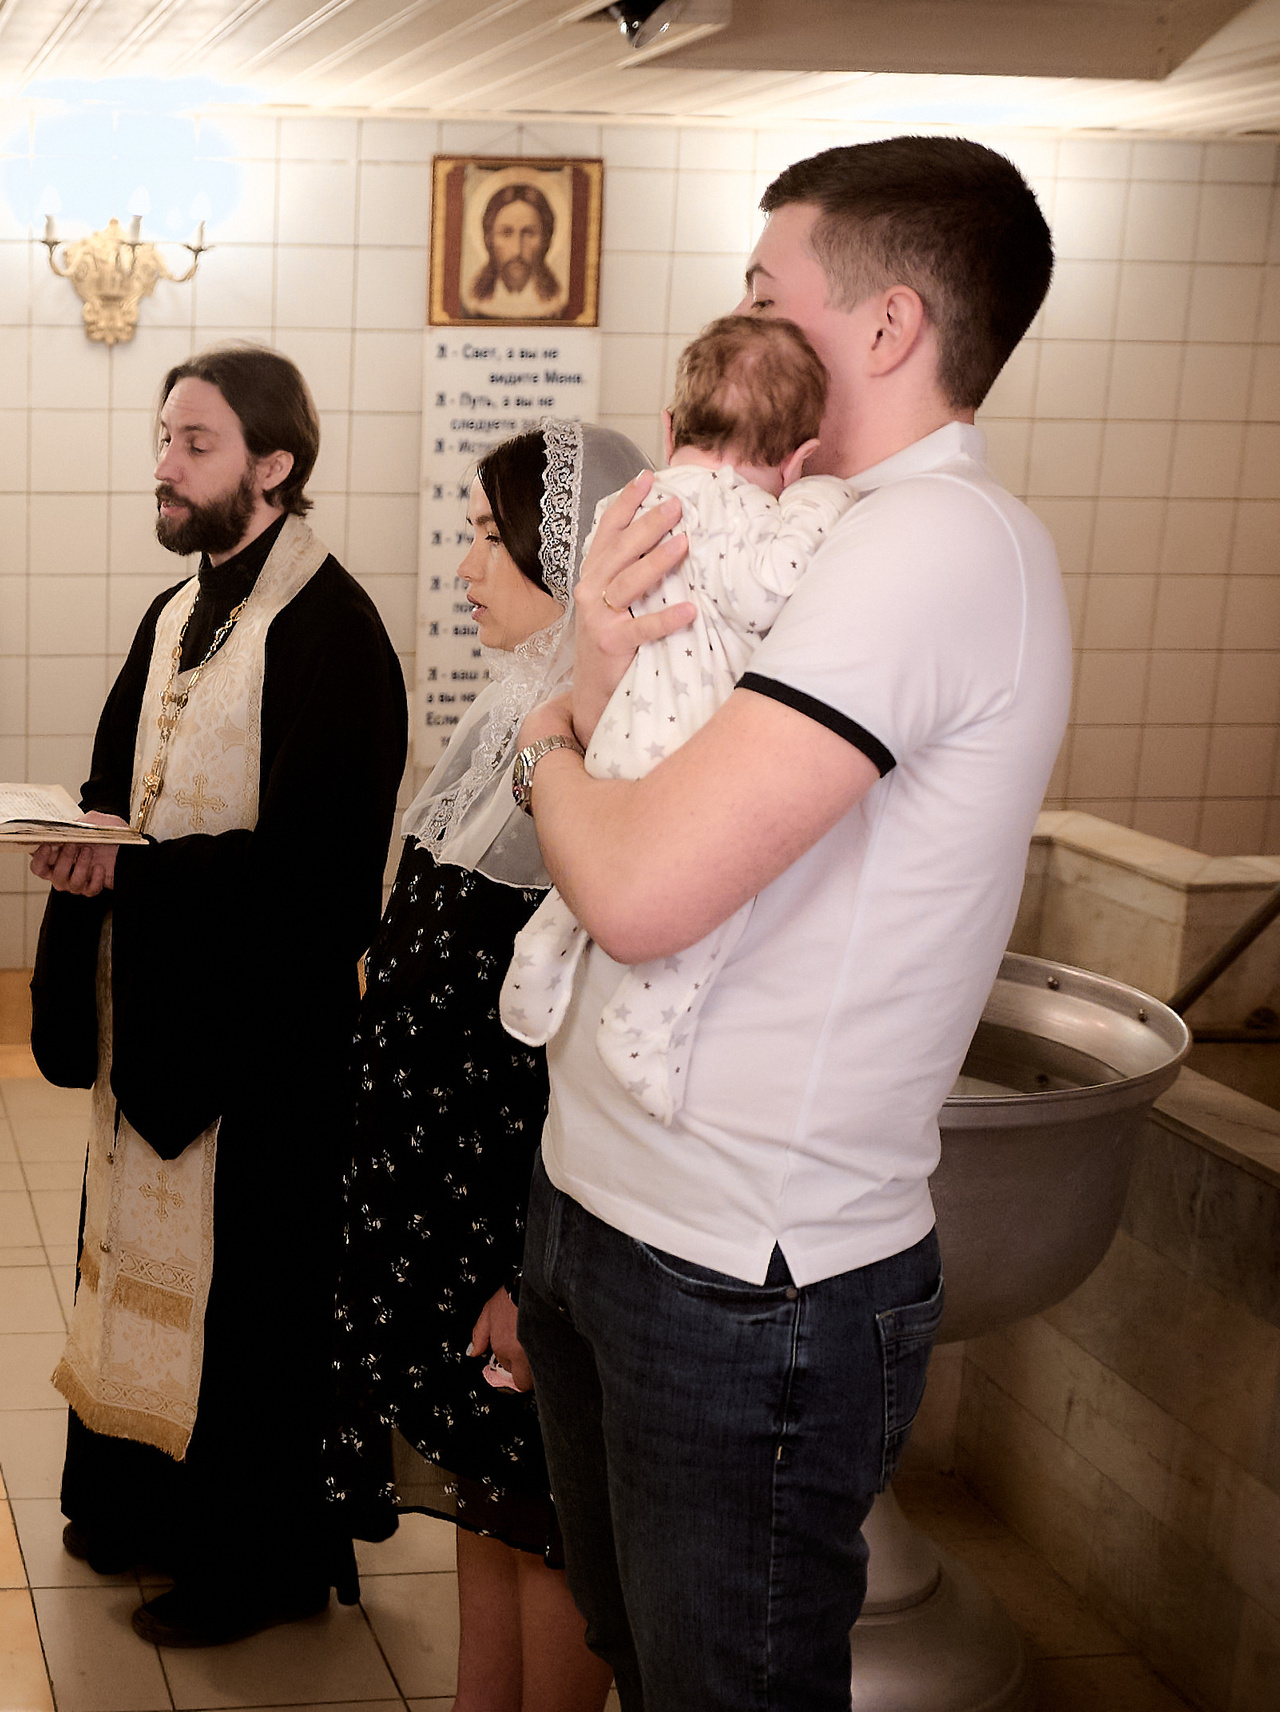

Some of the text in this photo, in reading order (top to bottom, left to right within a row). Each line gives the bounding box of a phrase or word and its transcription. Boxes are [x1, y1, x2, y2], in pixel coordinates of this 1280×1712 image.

[436, 343, 447, 359] Я
[507, 347, 514, 359] а
[519, 347, 537, 359] вы
[542, 347, 559, 359] не
[435, 392, 446, 407] Я
[516, 396, 532, 406] вы
[537, 396, 555, 406] не
